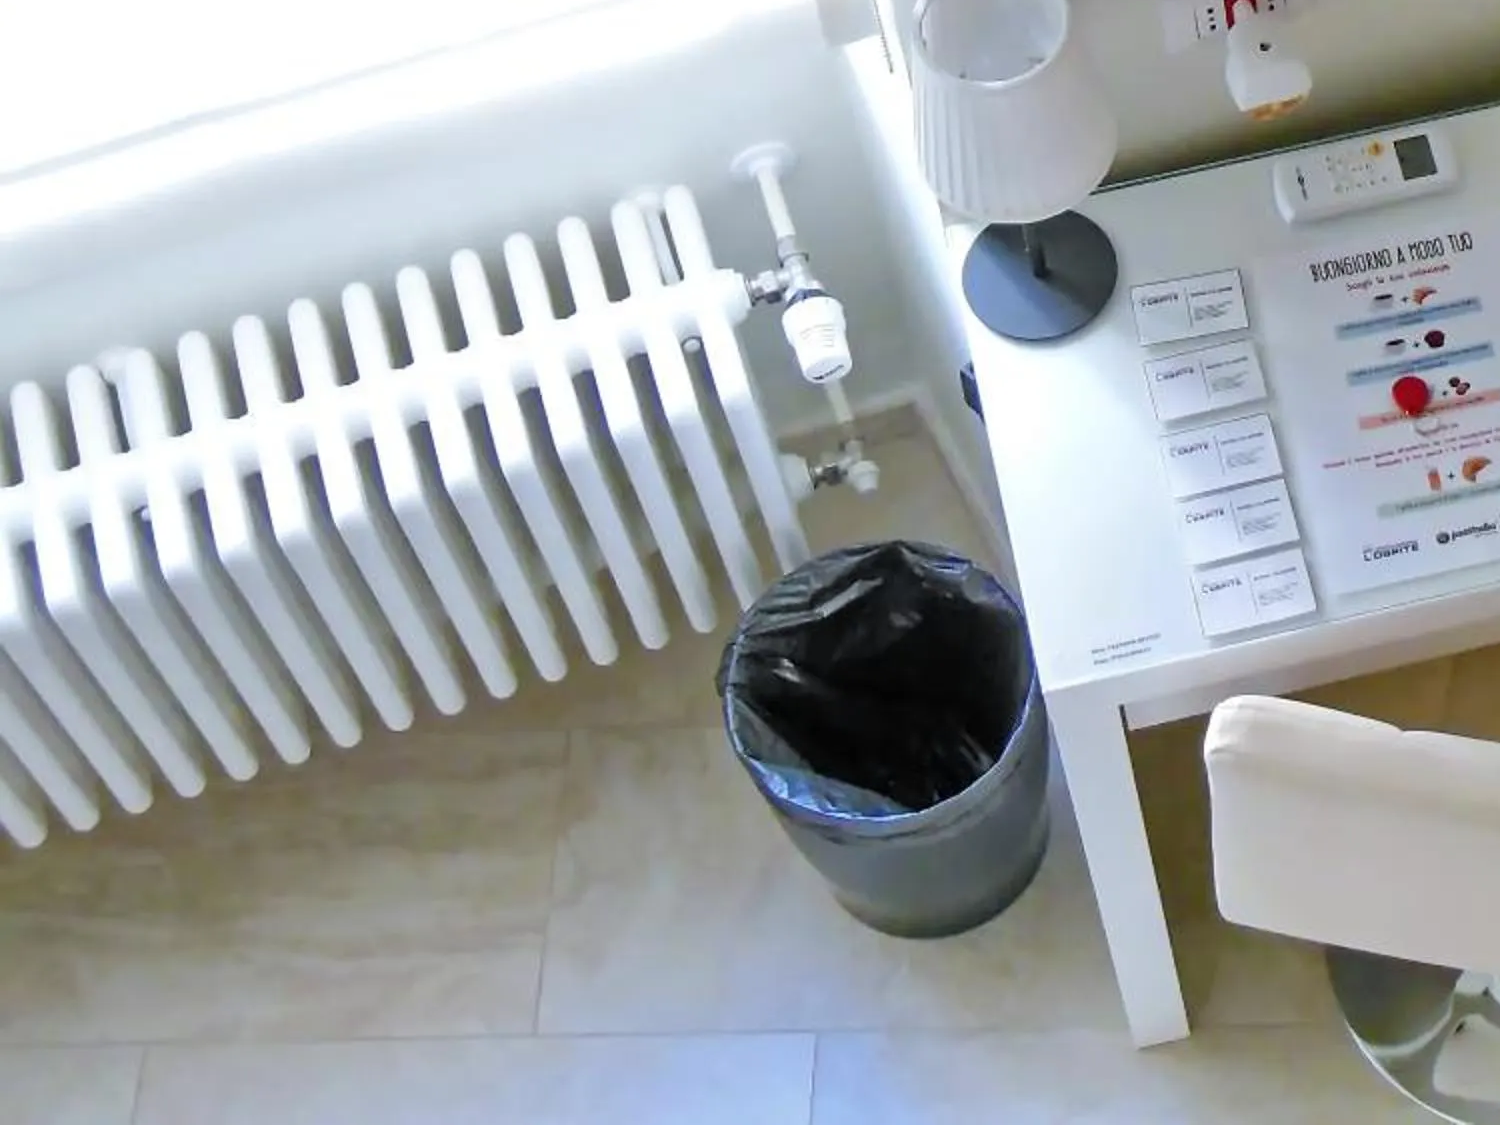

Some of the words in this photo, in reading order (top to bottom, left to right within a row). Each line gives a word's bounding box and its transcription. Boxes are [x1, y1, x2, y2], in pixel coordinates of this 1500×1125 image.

[1309, 248, 1393, 283] BUONGIORNO
[1397, 246, 1406, 265] A
[1407, 236, 1445, 261] MODO
[1448, 231, 1474, 254] TUO
